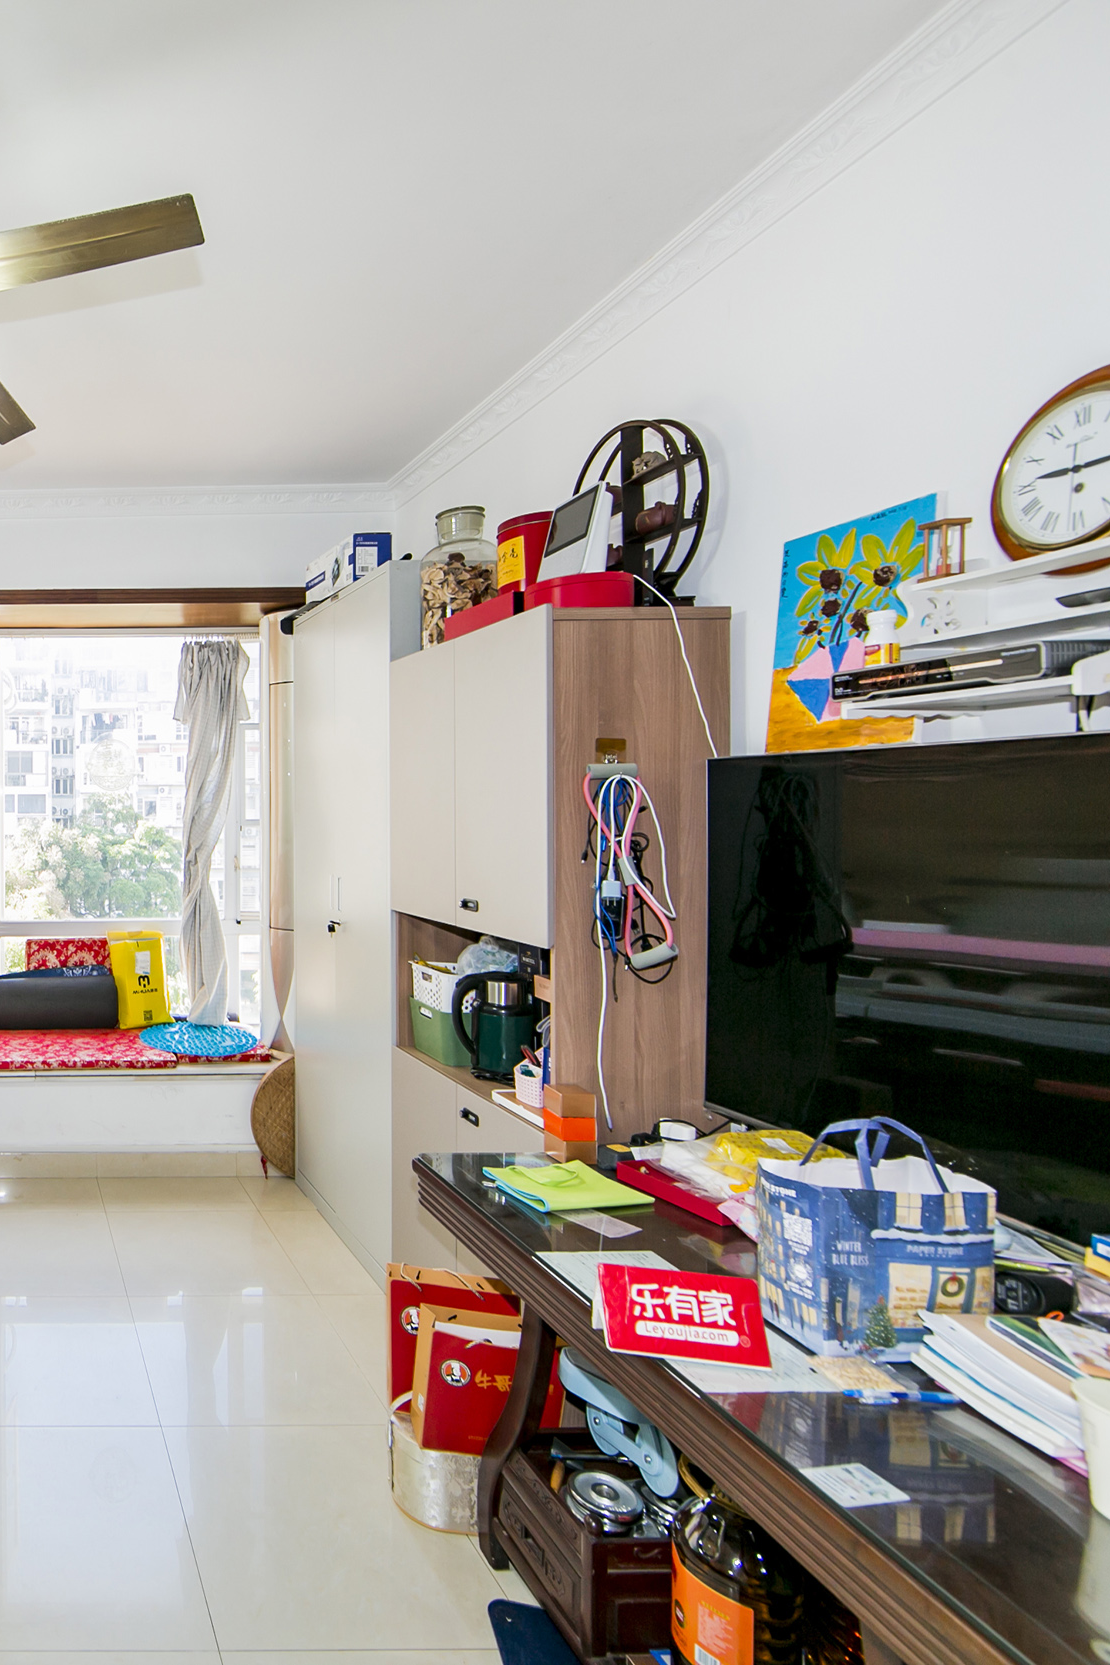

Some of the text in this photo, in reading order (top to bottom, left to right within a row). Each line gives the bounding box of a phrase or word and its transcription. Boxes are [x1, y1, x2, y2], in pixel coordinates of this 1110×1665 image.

[1073, 404, 1092, 430] XII
[1046, 423, 1064, 444] XI
[1026, 455, 1045, 466] X
[835, 1240, 862, 1253] WINTER
[906, 1244, 936, 1255] PAPER
[937, 1246, 965, 1256] STONE
[831, 1253, 870, 1267] BLUE BLISS
[630, 1283, 736, 1327] 乐有家
[644, 1321, 730, 1343] Leyoujia.com
